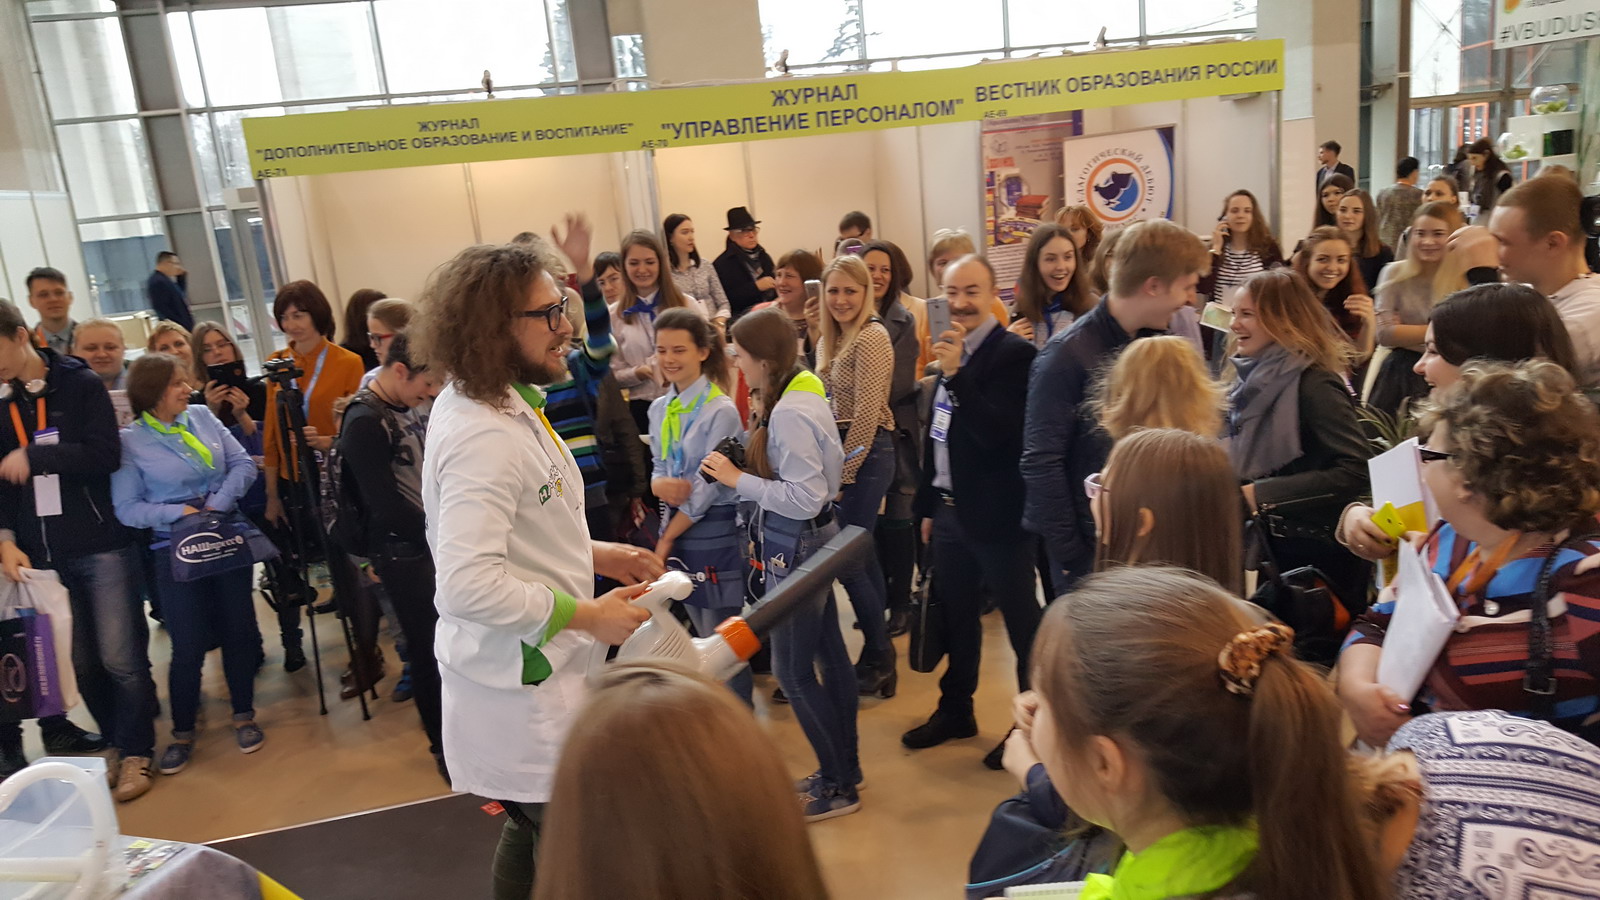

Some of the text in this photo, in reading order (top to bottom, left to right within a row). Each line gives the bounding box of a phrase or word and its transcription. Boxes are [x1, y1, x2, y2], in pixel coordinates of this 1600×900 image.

[1500, 11, 1600, 43] #VBUDUS
[770, 84, 858, 106] ЖУРНАЛ
[975, 59, 1278, 102] ВЕСТНИК ОБРАЗОВАНИЯ РОССИИ
[417, 118, 480, 132] ЖУРНАЛ
[661, 98, 964, 139] "УПРАВЛЕНИЕ ПЕРСОНАЛОМ"
[256, 123, 634, 161] "ДОПОЛНИТЕЛЬНОЕ ОБРАЗОВАНИЕ И ВОСПИТАНИЕ"
